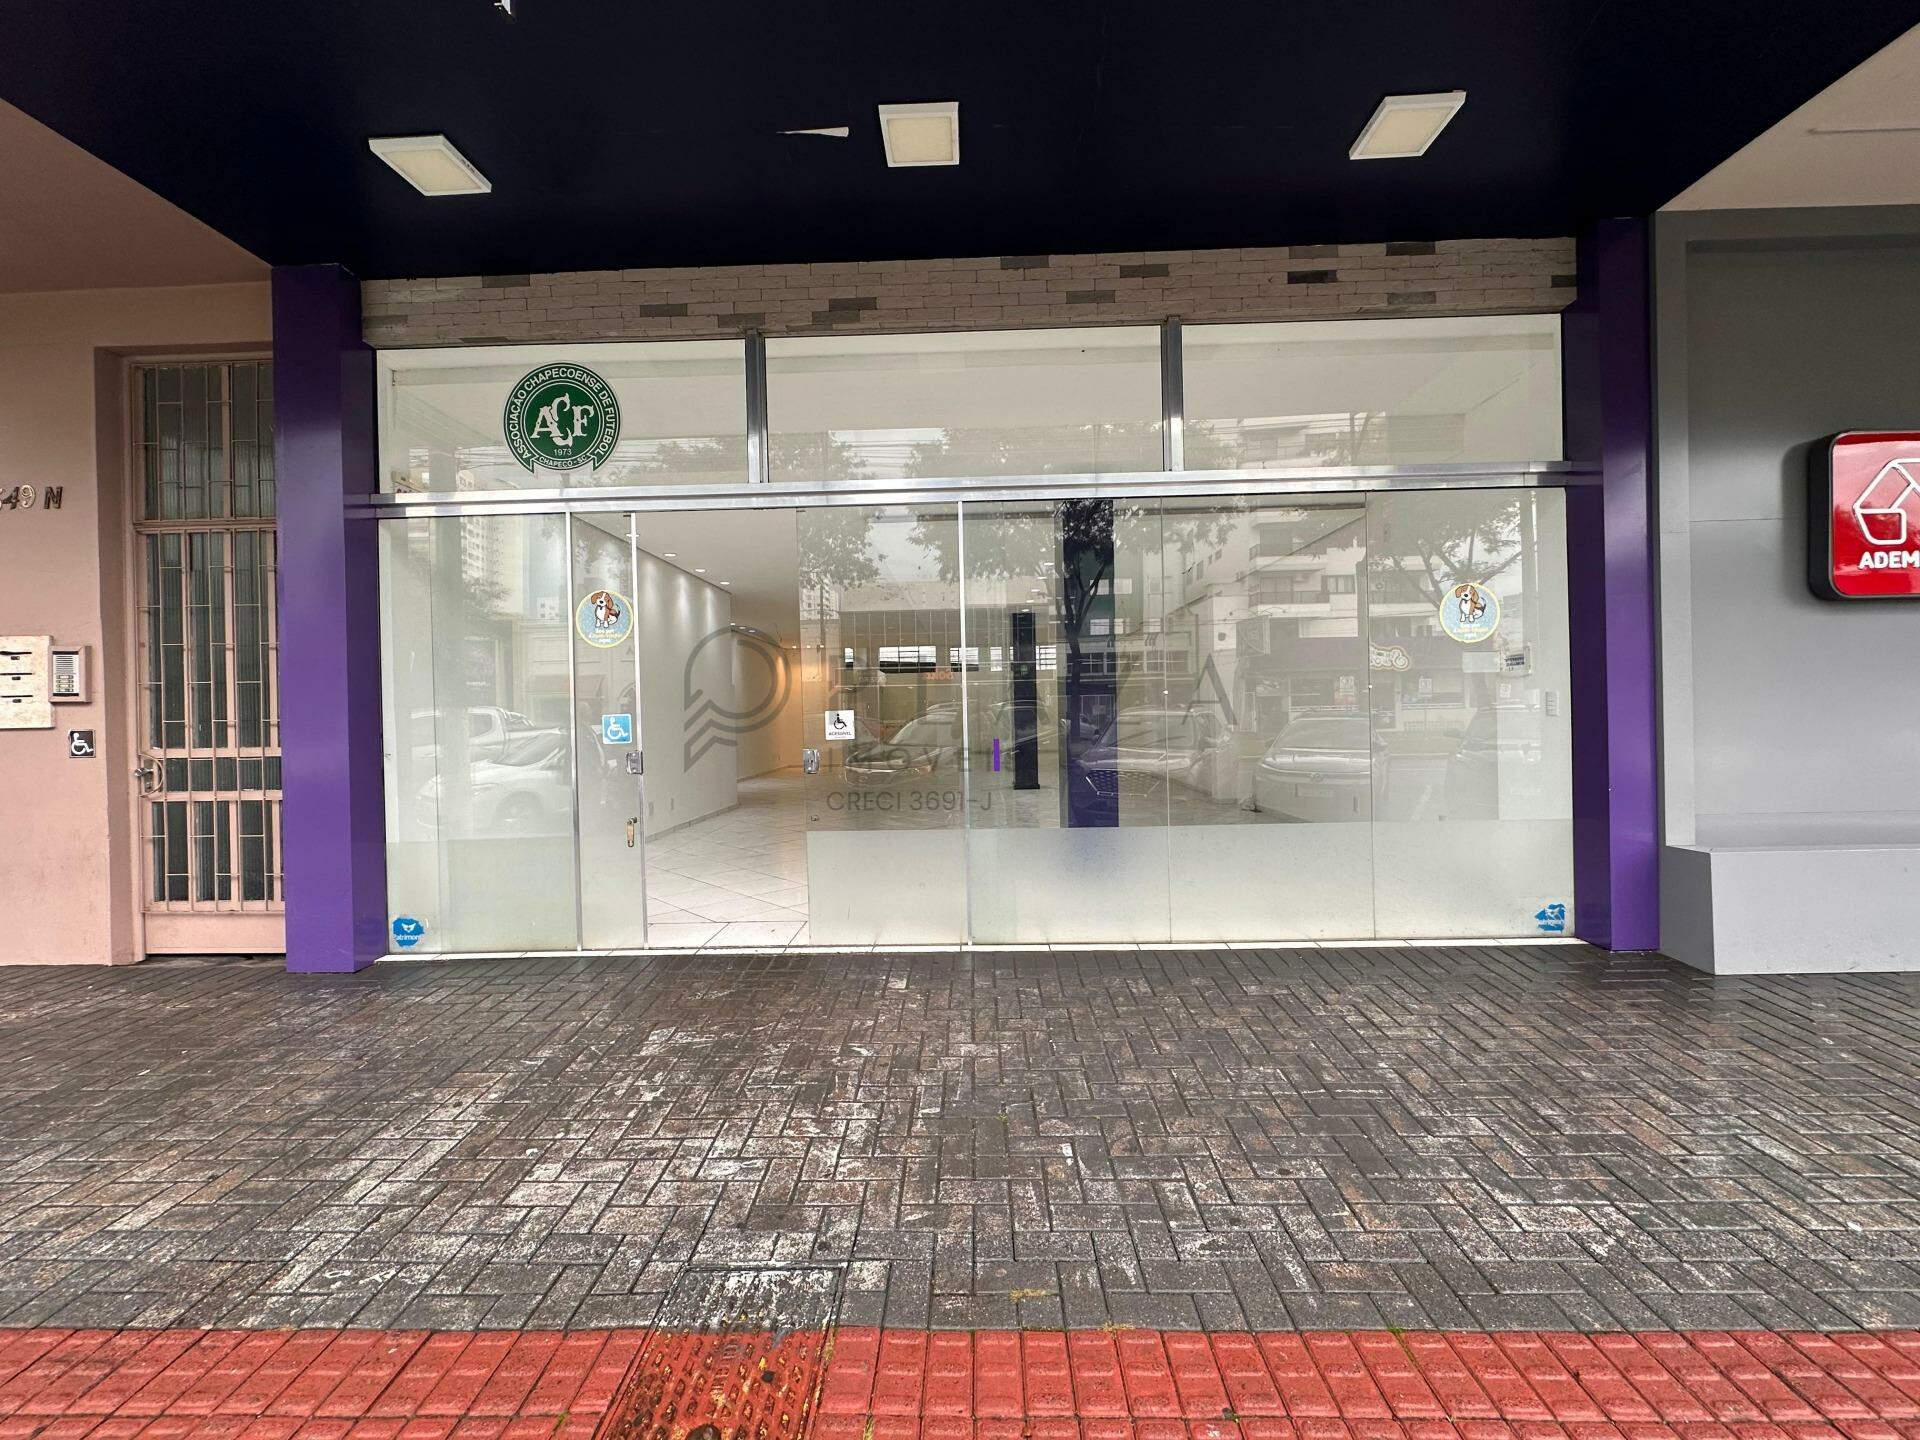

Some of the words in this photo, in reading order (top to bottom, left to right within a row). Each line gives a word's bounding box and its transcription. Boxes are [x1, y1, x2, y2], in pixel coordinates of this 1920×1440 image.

[524, 367, 602, 393] CHAPECOENSE
[598, 390, 612, 407] DE
[594, 407, 616, 455] FUTEBOL
[554, 448, 572, 456] 1973
[0, 485, 36, 510] 49
[43, 486, 63, 509] N
[1858, 550, 1920, 569] ADEM
